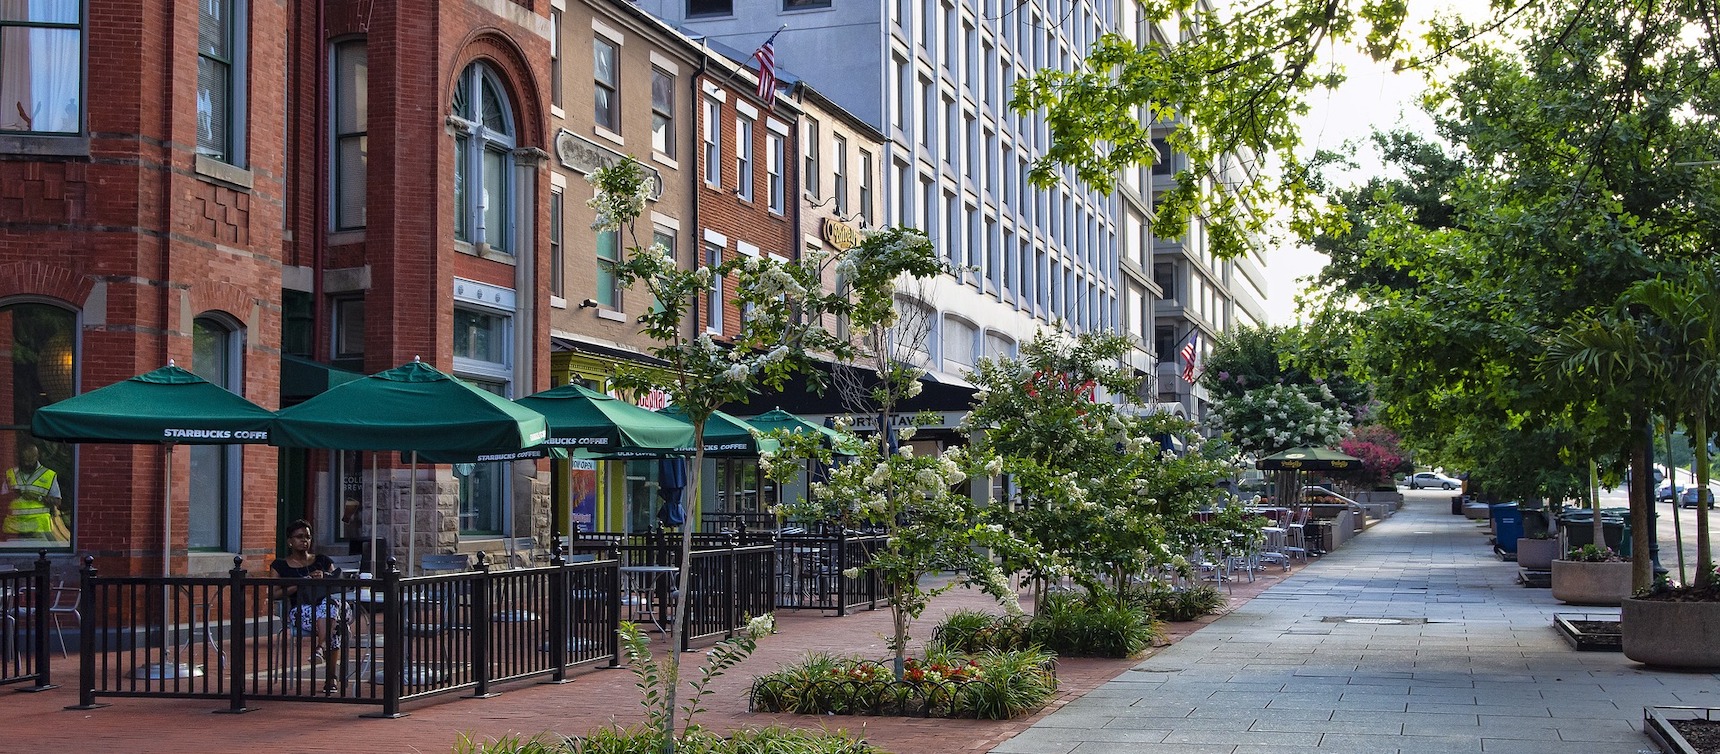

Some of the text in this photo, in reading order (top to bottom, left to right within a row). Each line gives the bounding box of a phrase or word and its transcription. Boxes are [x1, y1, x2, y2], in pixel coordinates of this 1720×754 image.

[164, 428, 268, 439] STARBUCKS COFFE
[543, 437, 609, 445] RBUCKS COFFEE
[477, 450, 541, 462] STARBUCKS COFFEE
